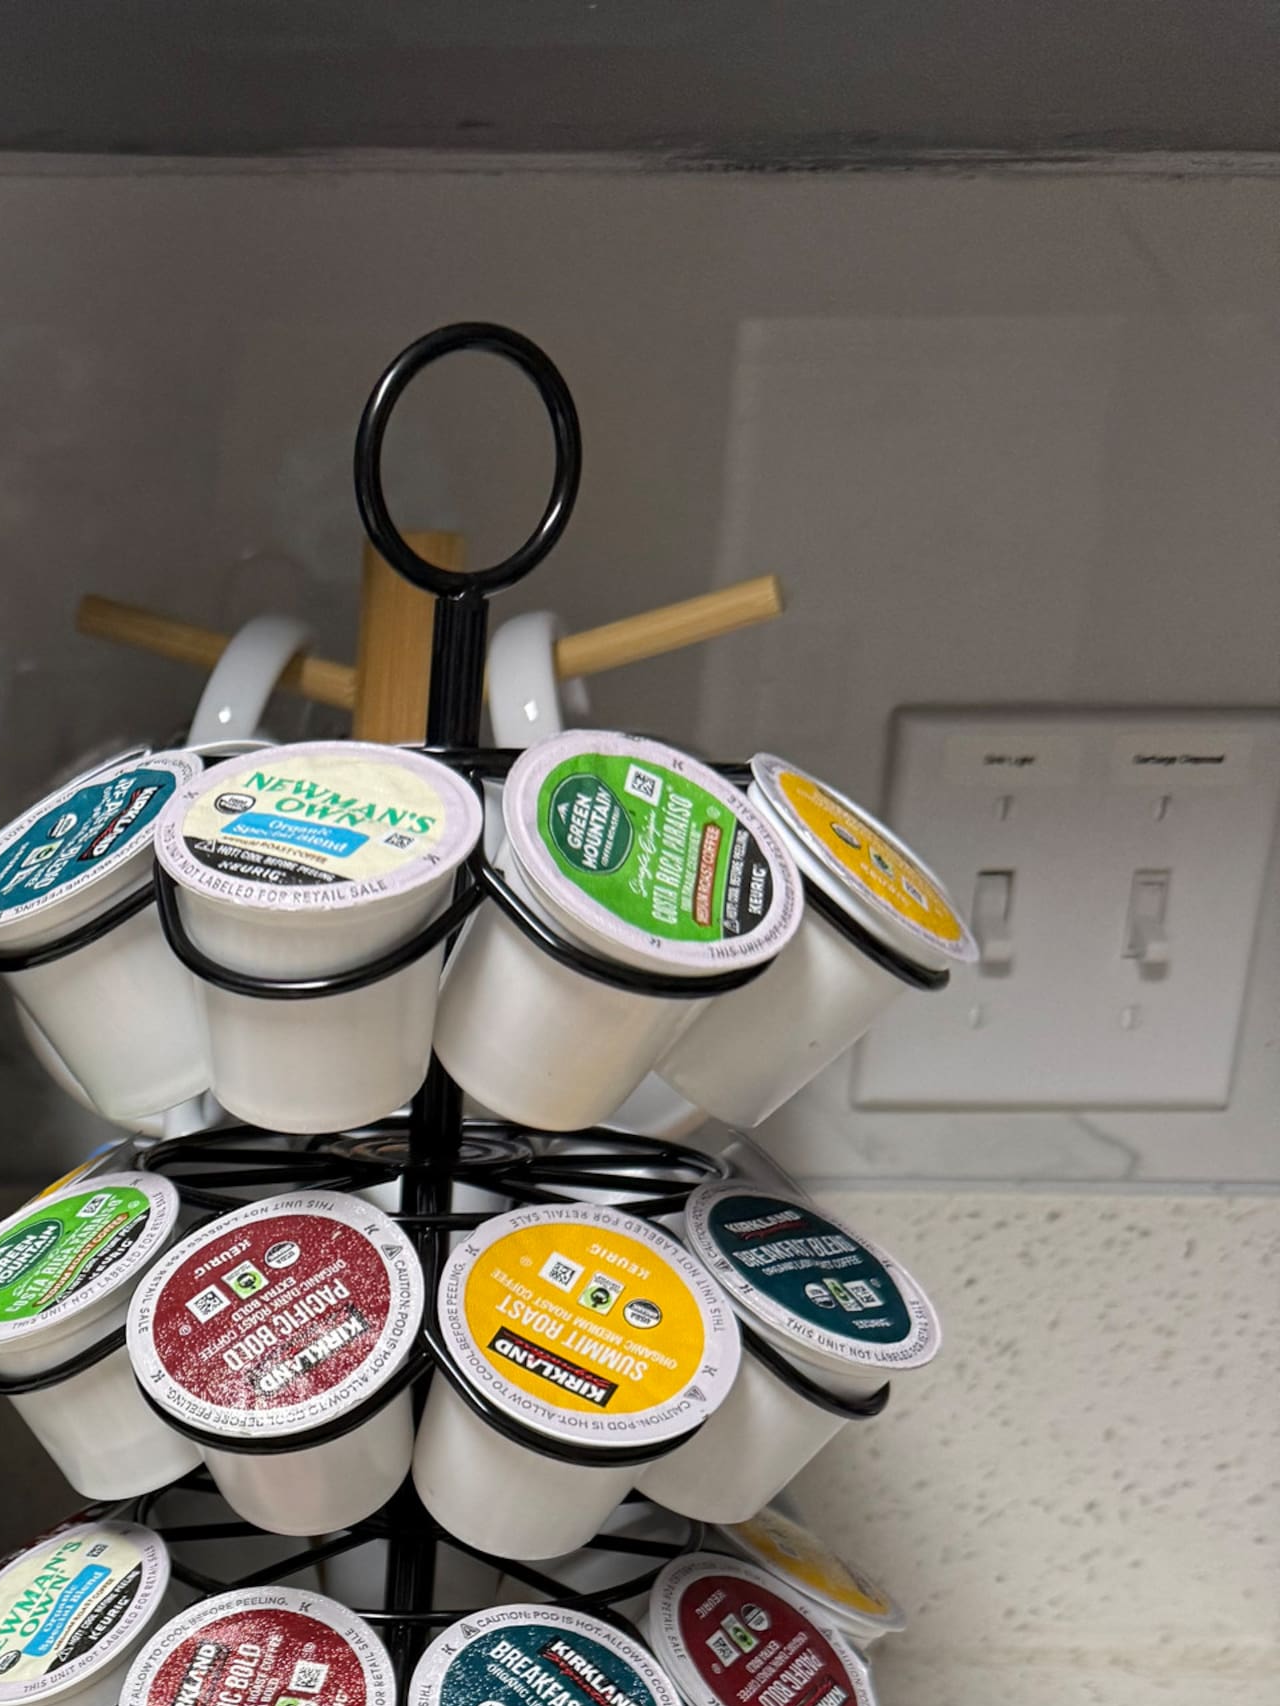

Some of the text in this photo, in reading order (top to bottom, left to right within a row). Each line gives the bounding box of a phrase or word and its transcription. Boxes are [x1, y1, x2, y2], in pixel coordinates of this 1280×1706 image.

[243, 772, 437, 834] NEWMAN'S
[274, 799, 364, 826] OWN
[567, 792, 593, 849] GREEN
[582, 786, 612, 869] MOUNTAIN
[218, 860, 283, 881] KEURIG
[652, 849, 685, 924] COSTA RICA
[748, 864, 767, 916] KEURIG
[509, 1208, 623, 1228] SALE RETAIL FOR
[723, 1210, 803, 1233] KIRKLAND
[138, 1200, 306, 1335] UNIT SALE
[193, 1239, 252, 1280] KEURIG
[588, 1242, 650, 1281] KEURIG
[732, 1234, 860, 1268] BREAKFAST BLEND
[40, 1250, 141, 1321] UNIT NOT LABELED
[231, 1276, 297, 1322] EXTRA BOLD
[490, 1269, 533, 1299] COFFEE
[222, 1279, 351, 1372] PACIFIC BOLD
[496, 1294, 649, 1382] SUMMIT ROAST
[785, 1317, 815, 1340] THIS
[817, 1335, 847, 1354] UNIT
[849, 1346, 872, 1360] NOT
[260, 1313, 365, 1392] KIRKLAND
[494, 1338, 609, 1403] KIRKLAND
[18, 1575, 71, 1638] OWN
[88, 1595, 131, 1640] KEURIG
[235, 1596, 289, 1607] PEELING.
[533, 1611, 560, 1622] POD
[23, 1679, 48, 1692] THIS
[50, 1665, 76, 1683] UNIT
[78, 1650, 99, 1668] NOT
[100, 1613, 138, 1651] LABELED
[226, 1643, 261, 1689] BOLD
